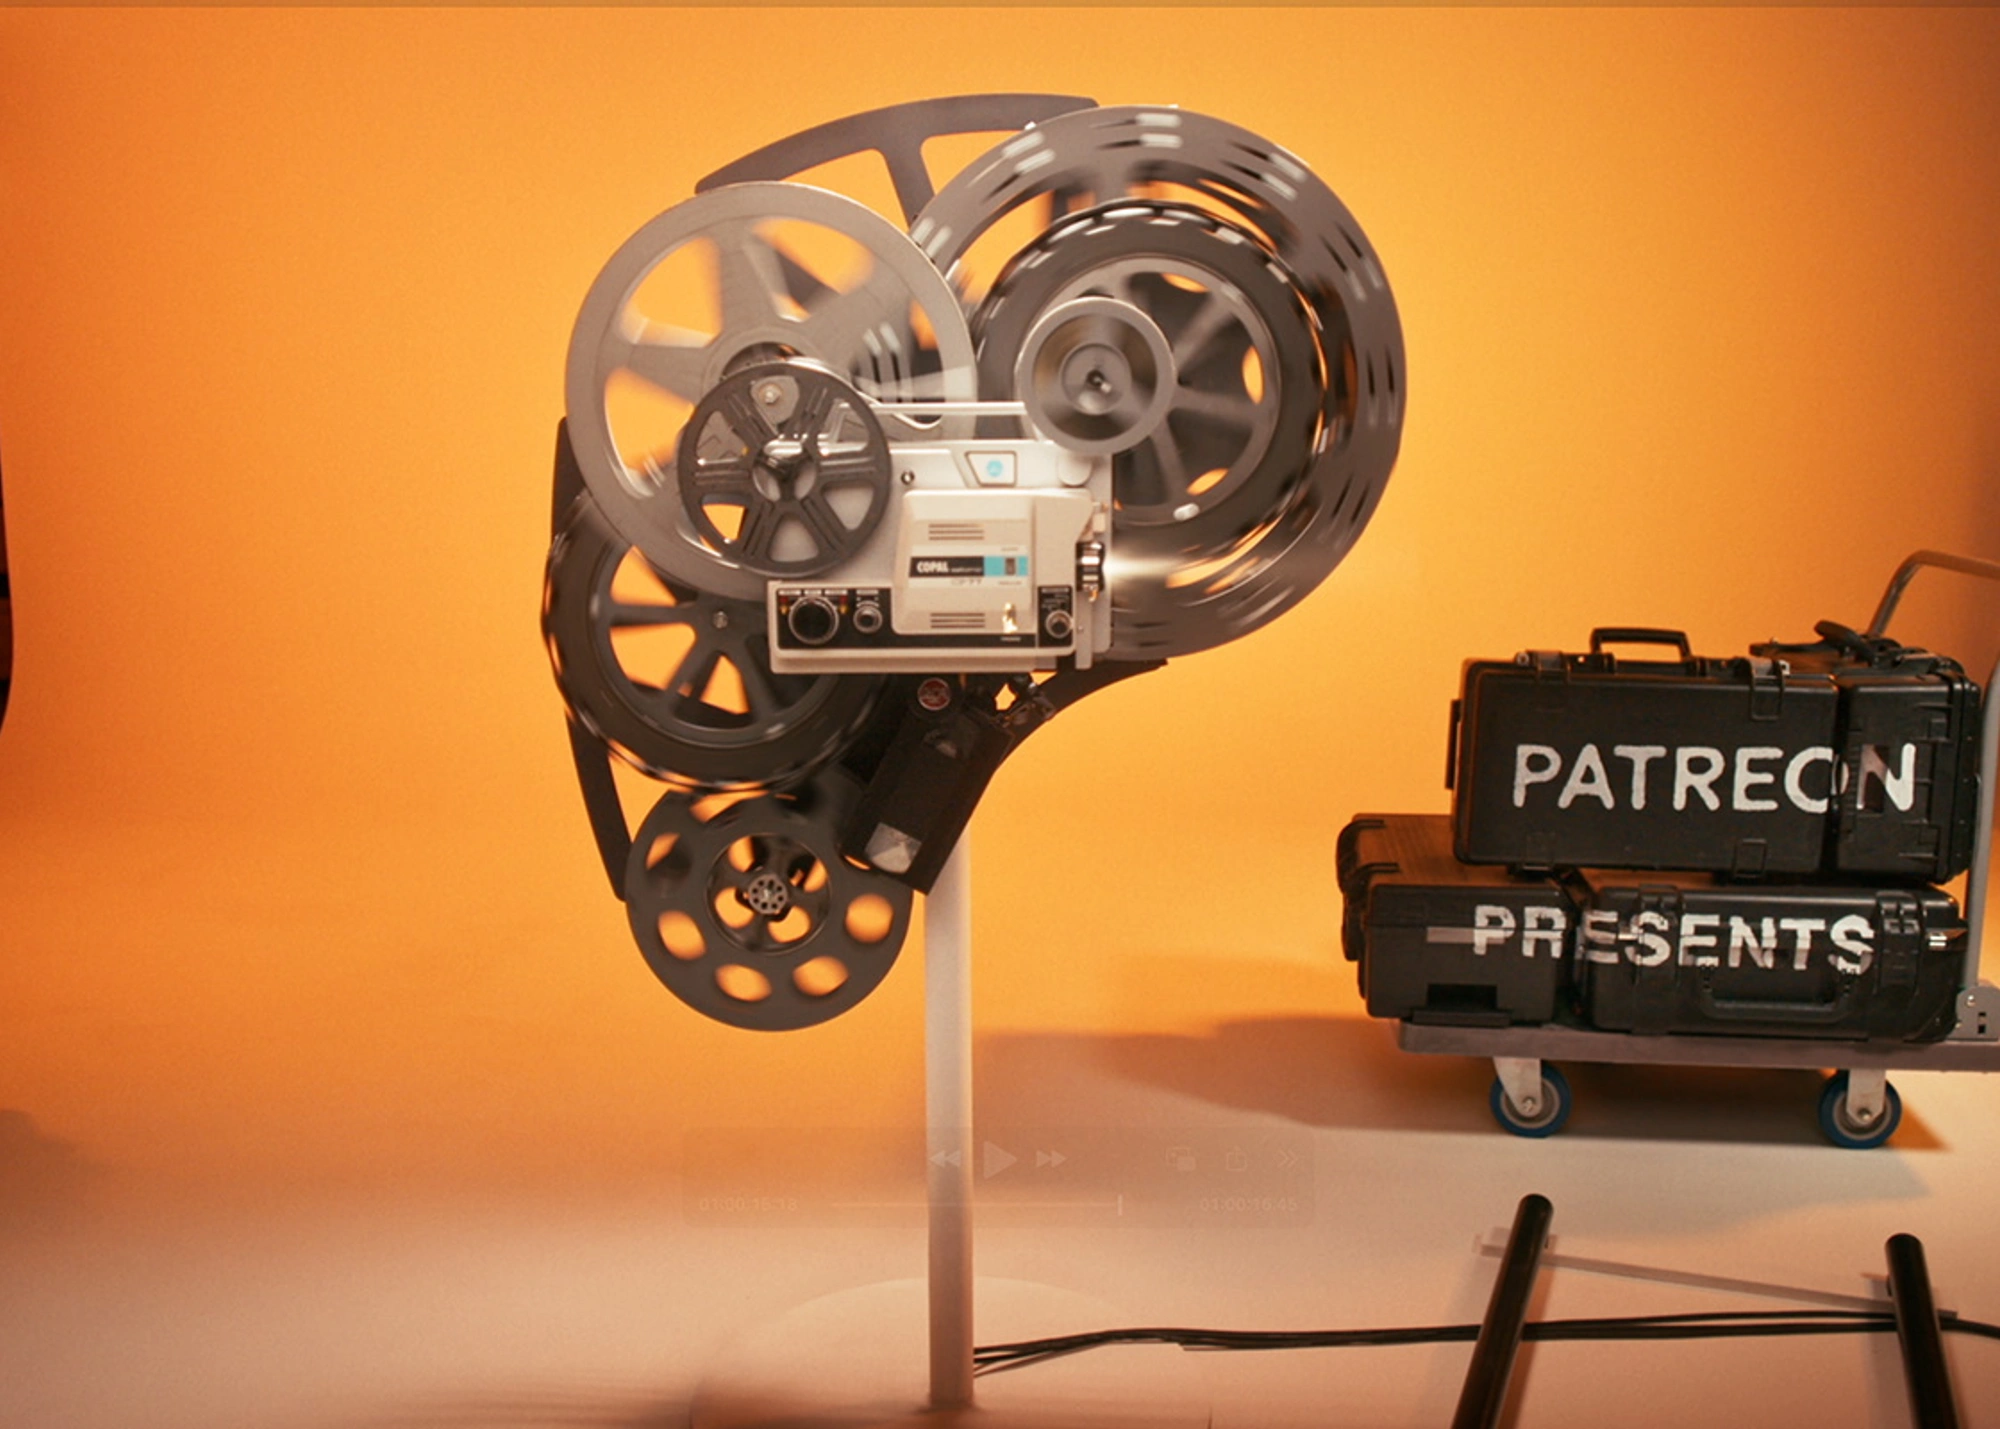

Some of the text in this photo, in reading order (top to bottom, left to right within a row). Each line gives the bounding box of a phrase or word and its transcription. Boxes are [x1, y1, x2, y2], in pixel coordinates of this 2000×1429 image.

[916, 560, 949, 574] COPAL
[1512, 742, 1917, 813] PATREON
[1471, 905, 1877, 975] PRESENTS
